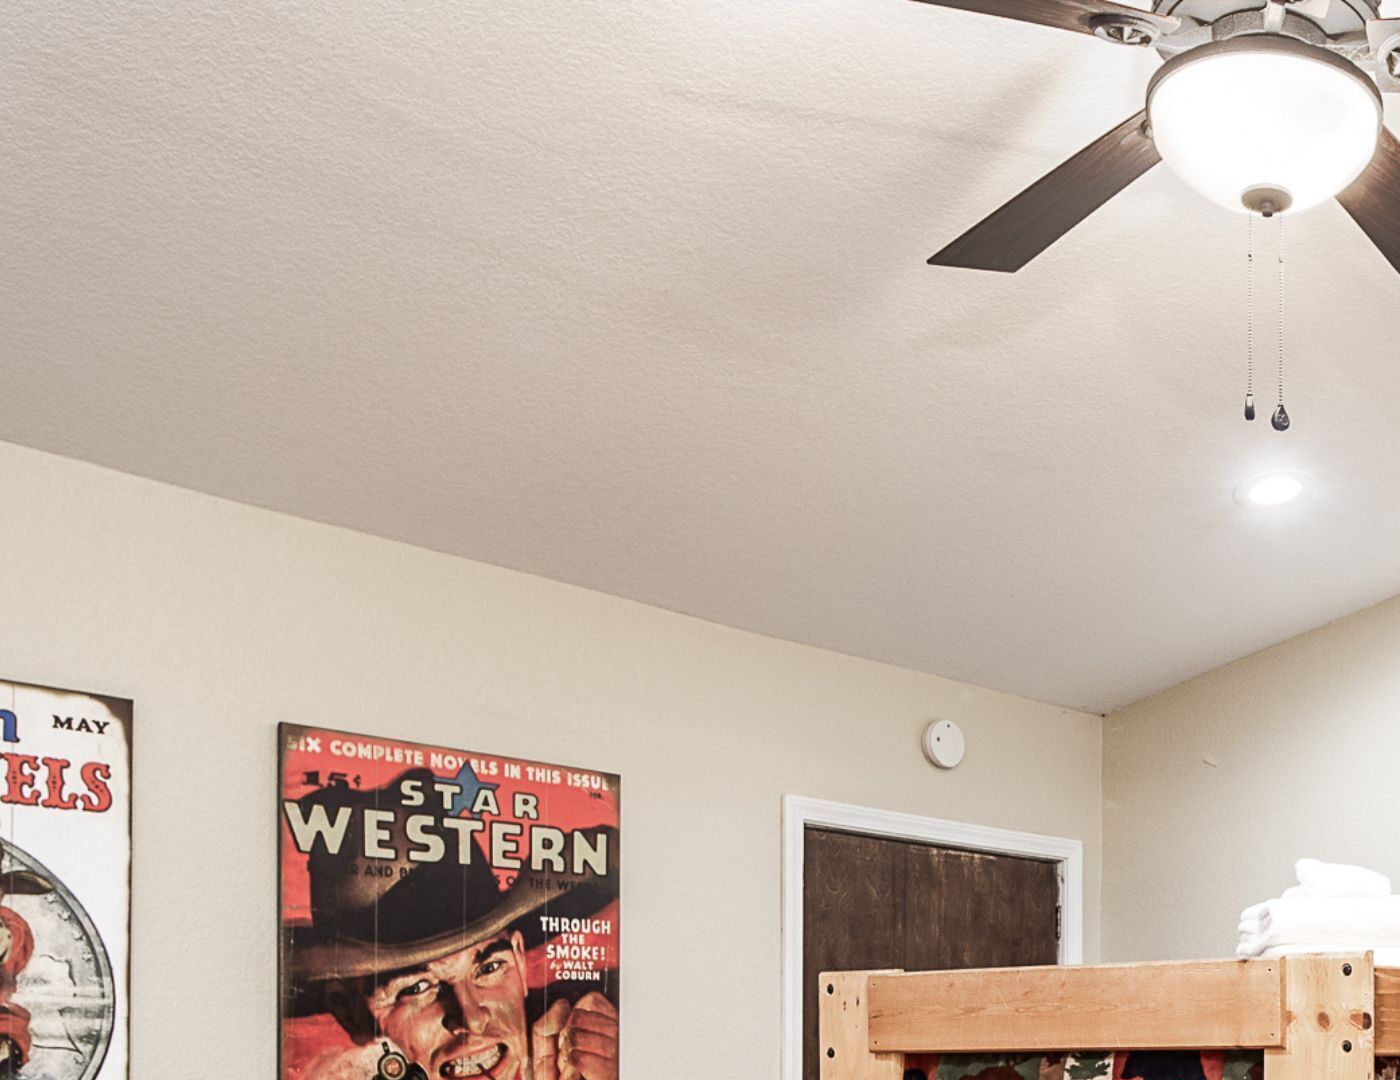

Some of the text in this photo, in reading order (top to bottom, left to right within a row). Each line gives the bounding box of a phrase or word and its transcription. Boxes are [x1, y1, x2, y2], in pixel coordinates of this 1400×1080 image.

[52, 714, 110, 734] MAY
[286, 734, 322, 753] SIX
[329, 740, 424, 766] COMPLETE
[430, 752, 498, 776] NOVELS
[504, 763, 521, 780] IN
[525, 766, 562, 785] THIS
[400, 779, 539, 820] STAR
[283, 801, 608, 876] WESTERN
[364, 864, 394, 878] AND
[540, 915, 612, 935] THROUGH
[561, 933, 585, 945] THE
[546, 944, 606, 961] SMOKE!
[563, 960, 594, 970] WALT
[555, 970, 600, 981] COBURN
